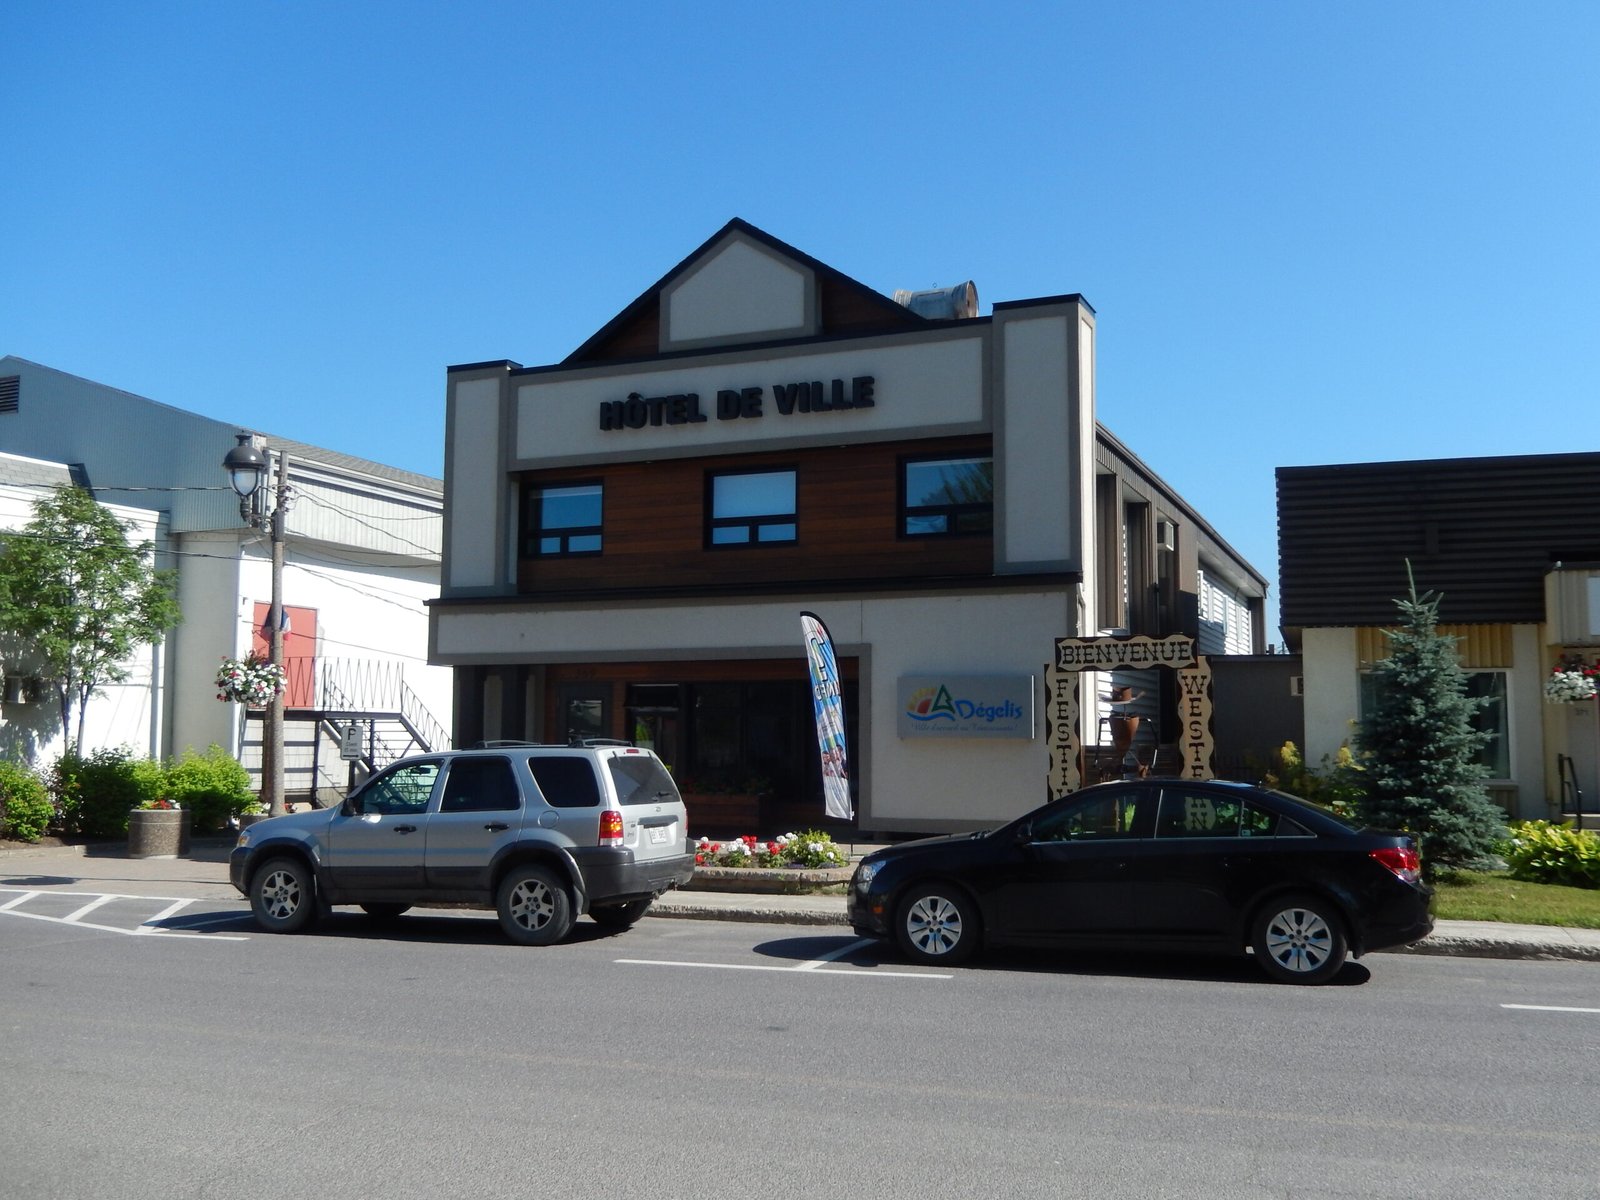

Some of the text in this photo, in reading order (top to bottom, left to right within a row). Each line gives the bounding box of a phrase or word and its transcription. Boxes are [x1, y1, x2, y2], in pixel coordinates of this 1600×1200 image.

[600, 376, 875, 431] HÔTEL DE VILLE
[1062, 641, 1191, 665] BIENVENUE
[954, 699, 1023, 722] Dégelis
